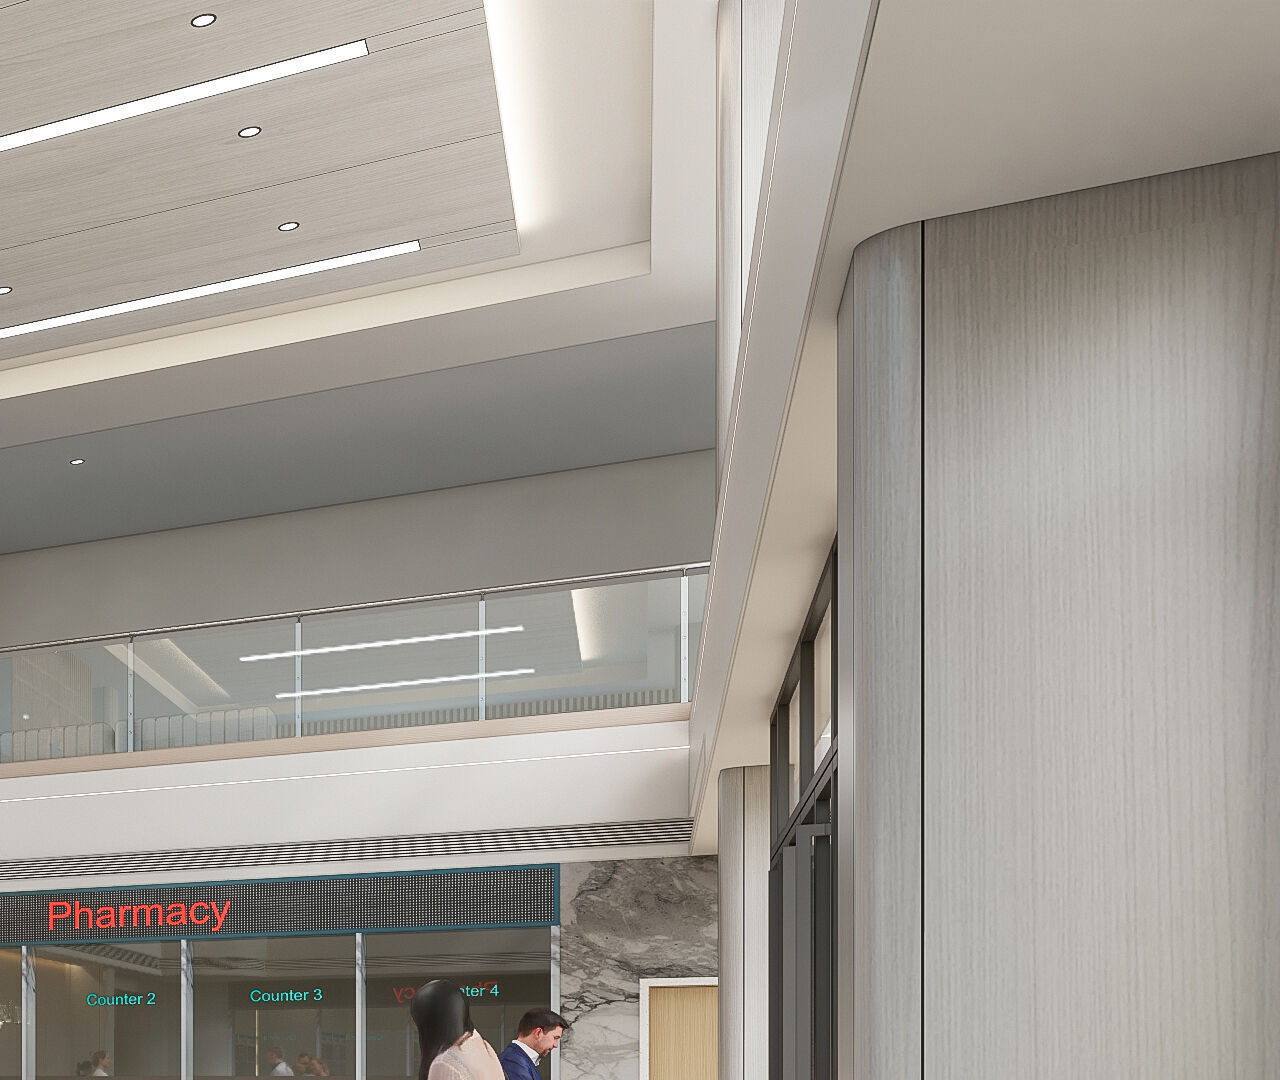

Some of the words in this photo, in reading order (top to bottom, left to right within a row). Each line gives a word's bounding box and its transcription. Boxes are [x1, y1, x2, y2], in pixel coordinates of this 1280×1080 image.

[48, 900, 232, 932] Pharmacy
[249, 988, 310, 1002] Counter
[313, 988, 323, 1001] 3
[489, 983, 500, 997] 4
[86, 993, 144, 1006] Counter
[146, 992, 156, 1005] 2
